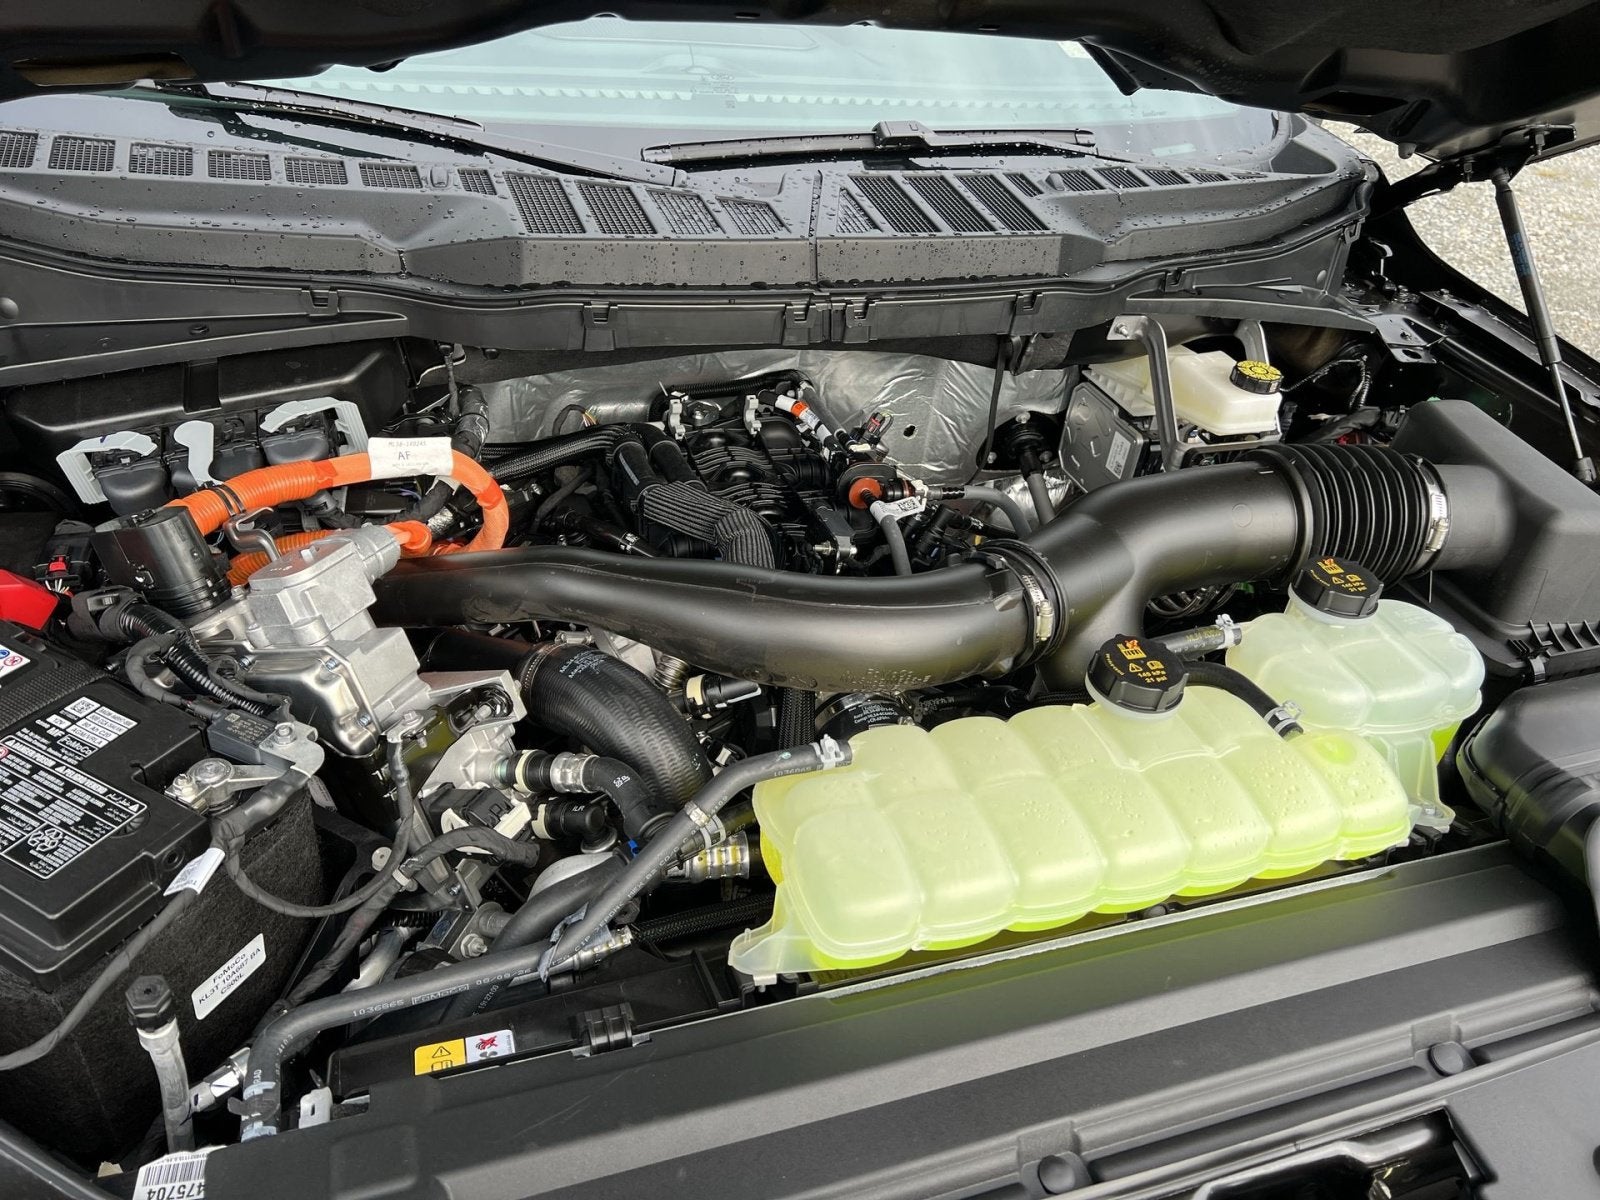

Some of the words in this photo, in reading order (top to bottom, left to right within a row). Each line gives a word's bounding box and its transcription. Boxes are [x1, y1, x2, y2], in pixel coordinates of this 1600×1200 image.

[398, 451, 411, 460] AF
[63, 736, 92, 755] FoMoCo
[213, 953, 246, 983] FoMoCo
